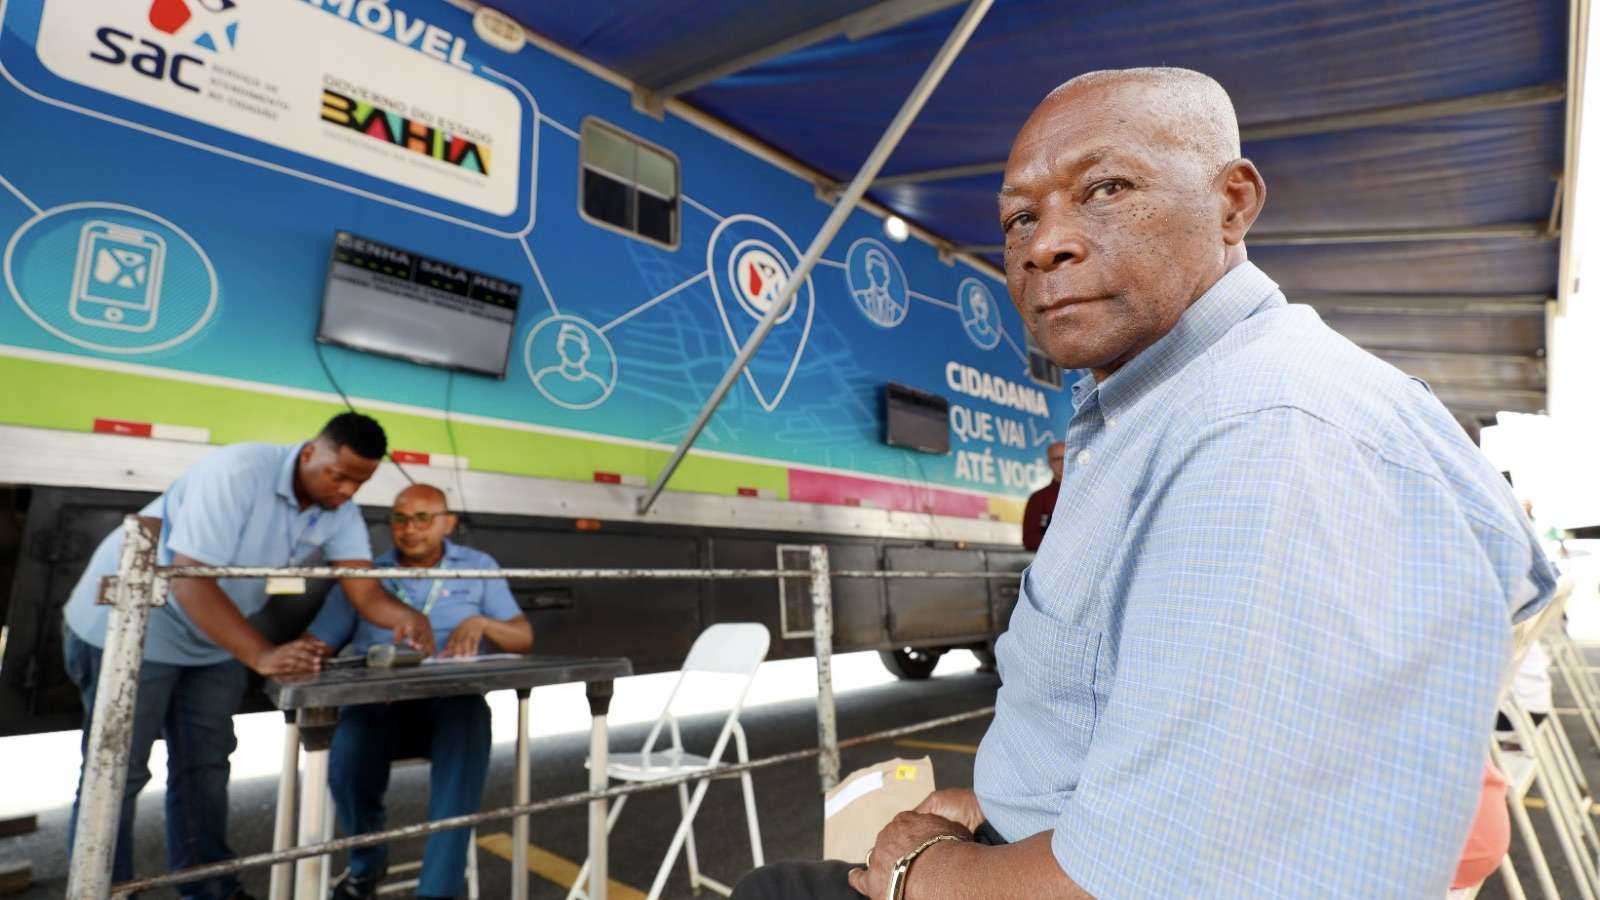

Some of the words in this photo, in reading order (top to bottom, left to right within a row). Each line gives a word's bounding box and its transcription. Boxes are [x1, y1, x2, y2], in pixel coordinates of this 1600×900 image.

[320, 88, 490, 176] BAHIA
[946, 361, 1049, 417] CIDADANIA
[950, 405, 994, 443] QUE
[996, 417, 1026, 449] VAI
[954, 448, 996, 485] ATÉ
